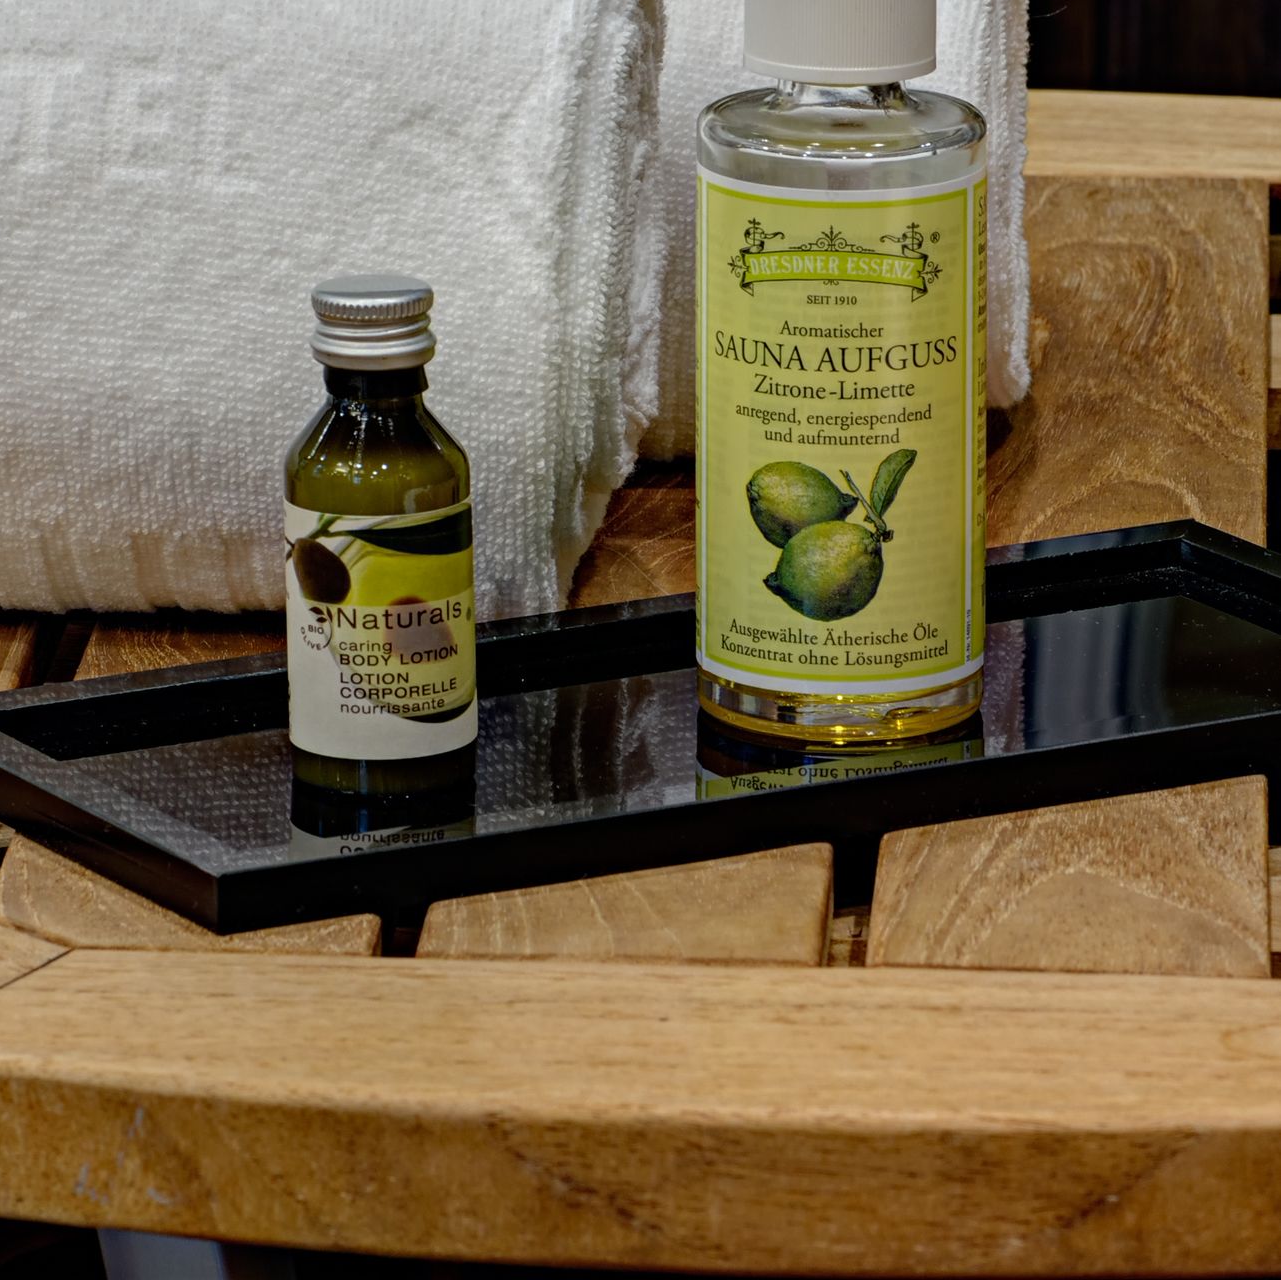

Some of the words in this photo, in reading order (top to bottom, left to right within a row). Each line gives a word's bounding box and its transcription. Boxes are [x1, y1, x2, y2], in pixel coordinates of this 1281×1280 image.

[750, 256, 839, 276] DRESDNER
[847, 256, 916, 279] ESSENZ
[807, 295, 831, 305] SEIT
[834, 296, 857, 305] 1910
[780, 320, 884, 338] Aromatischer
[715, 330, 807, 371] SAUNA
[815, 336, 957, 373] AUFGUSS
[753, 374, 915, 400] Zitrone-Limette
[735, 404, 801, 426] anregend,
[807, 404, 932, 429] energiespendend
[765, 428, 793, 444] und
[798, 428, 900, 445] aufmunternd
[337, 600, 462, 630] Naturals
[308, 624, 325, 635] BIO
[729, 618, 818, 645] Ausgewählte
[823, 628, 909, 646] Ätherische
[913, 622, 939, 640] Öle
[339, 640, 392, 654] caring
[340, 654, 392, 666] BODY
[400, 644, 459, 665] LOTION
[721, 634, 793, 664] Konzentrat
[799, 652, 839, 666] ohne
[845, 640, 948, 668] Lösungsmittel
[340, 672, 410, 685] LOTION
[340, 678, 457, 699] CORPORELLE
[340, 698, 445, 714] nourrissante
